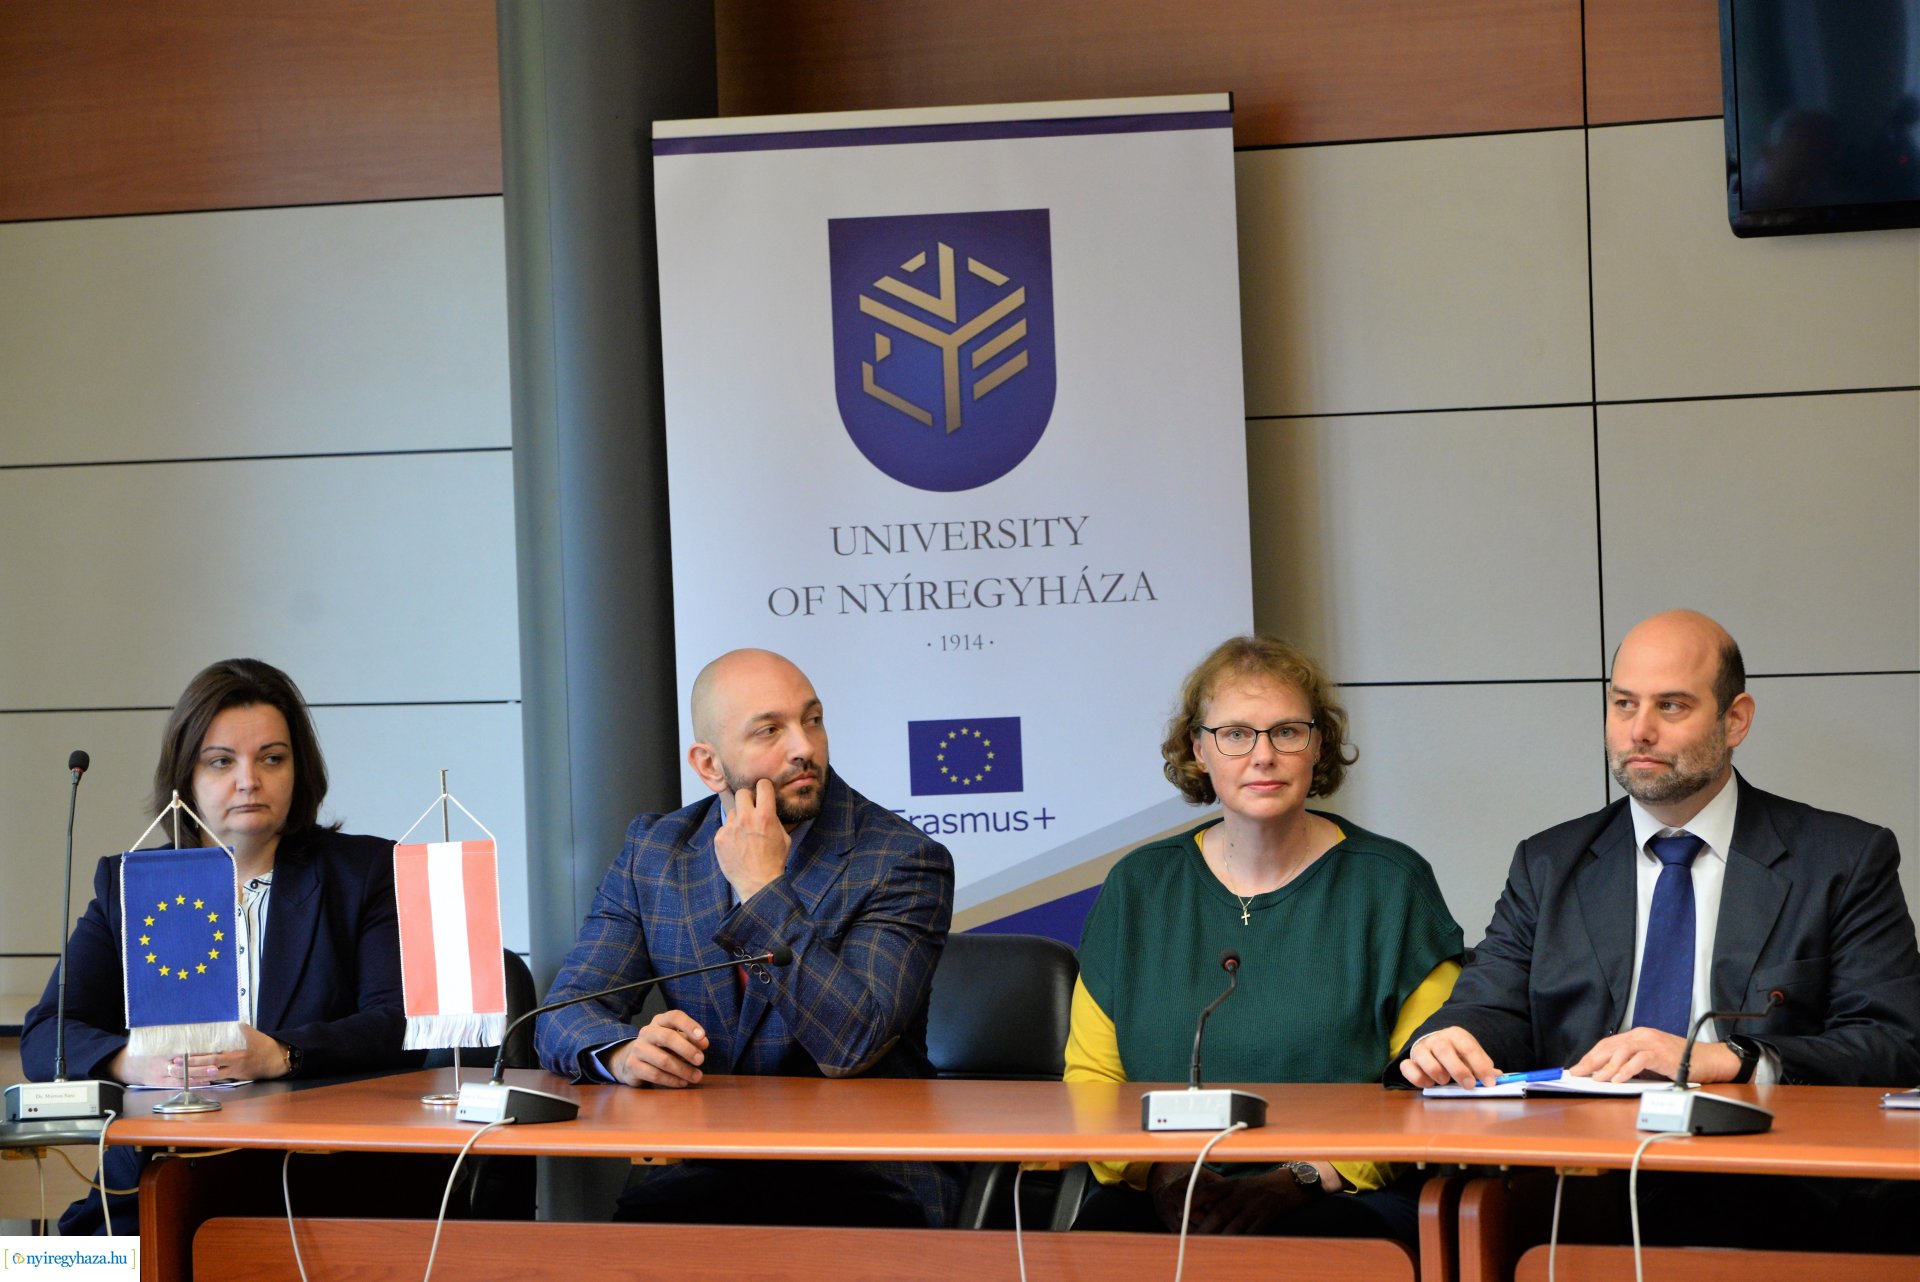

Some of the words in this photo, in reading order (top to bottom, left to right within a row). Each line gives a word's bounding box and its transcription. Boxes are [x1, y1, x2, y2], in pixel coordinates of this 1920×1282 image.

[829, 515, 1089, 556] UNIVERSITY
[768, 585, 825, 617] OF
[837, 566, 1158, 614] NYÍREGYHÁZA
[890, 807, 1056, 835] rasmus+
